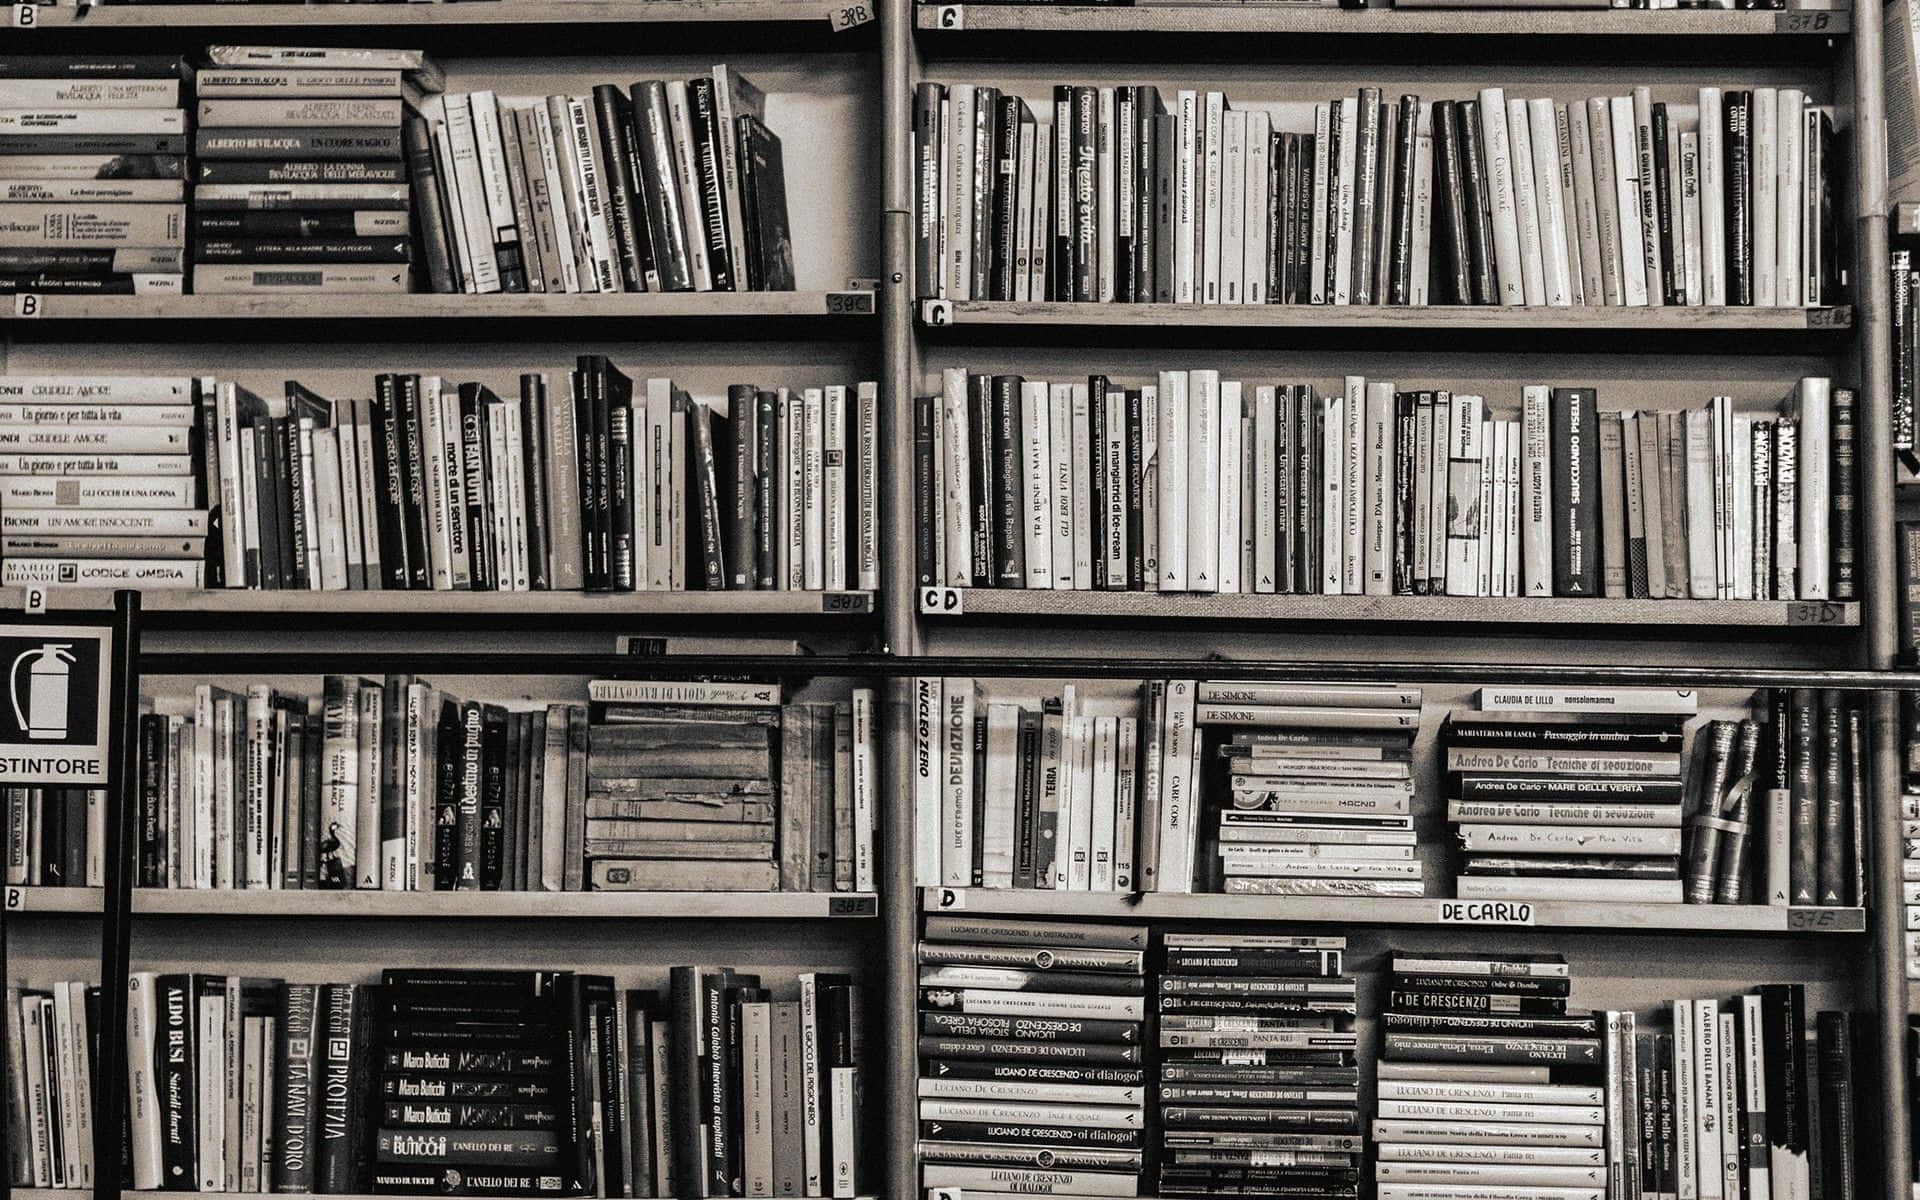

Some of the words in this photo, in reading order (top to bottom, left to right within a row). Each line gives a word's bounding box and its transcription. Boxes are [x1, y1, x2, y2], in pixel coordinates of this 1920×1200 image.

[20, 5, 33, 25] B
[840, 5, 867, 28] 38B
[1080, 94, 1091, 135] Costanzo
[1730, 106, 1738, 132] COVITO
[1738, 106, 1746, 137] CARMEN
[206, 139, 246, 148] ALBERTO
[247, 139, 300, 148] BEVILACQUA
[355, 139, 391, 147] MAGICO
[1558, 111, 1569, 158] COSTANTINI
[269, 170, 318, 180] BEVILACQUA
[324, 171, 348, 179] DELLE
[349, 171, 397, 179] MERAVIGLIE
[1562, 162, 1571, 188] Veleno
[1684, 152, 1696, 178] Carmen
[1302, 167, 1311, 208] CASANOVA
[1684, 178, 1696, 198] Covito
[1302, 211, 1309, 220] DI
[1301, 222, 1309, 248] AMORI
[23, 295, 36, 316] B
[1002, 382, 1011, 416] RAFFAELE
[22, 408, 33, 420] Un
[35, 411, 59, 424] giorno
[60, 411, 66, 420] e
[67, 411, 80, 425] per
[81, 408, 98, 420] tutta
[100, 408, 109, 420] la
[110, 408, 121, 420] vita
[1569, 394, 1581, 433] PISELLI
[1003, 418, 1012, 439] CROVI
[1111, 440, 1122, 449] le
[1779, 427, 1796, 483] DEVIAZIONE
[446, 442, 460, 476] morte
[1003, 448, 1014, 491] L'indagine
[1569, 435, 1581, 504] SBUCCIANDO
[449, 479, 462, 488] di
[1060, 462, 1069, 491] VINTI
[1111, 450, 1122, 502] mangiatrici
[451, 489, 461, 503] un
[1004, 493, 1014, 502] di
[1060, 494, 1069, 517] EROI
[1299, 500, 1309, 509] al
[1005, 503, 1014, 515] via
[1111, 504, 1122, 513] di
[4, 517, 40, 526] BIONDI
[48, 517, 61, 526] UN
[62, 517, 97, 526] AMORE
[99, 517, 152, 526] INNOCENTE
[451, 506, 465, 554] senatore
[1060, 520, 1069, 537] GLI
[1299, 510, 1309, 533] mare
[1005, 518, 1016, 549] Rapallo
[1111, 513, 1122, 560] ice-cream
[7, 573, 55, 581] BIONDI
[82, 569, 129, 578] CODICE
[136, 569, 183, 578] OMBRA
[30, 590, 42, 608] B
[926, 590, 940, 608] C
[945, 590, 958, 610] D
[1208, 692, 1221, 701] DE
[1222, 692, 1257, 701] SIMONE
[1494, 695, 1523, 705] CLAUDIA
[1525, 695, 1534, 705] DE
[1535, 695, 1554, 705] LILLO
[1564, 695, 1615, 705] nonsolomamma
[919, 680, 929, 737] NUCLEO
[1206, 711, 1219, 720] DE
[1220, 711, 1255, 720] SIMONE
[464, 710, 483, 748] pugno
[950, 695, 964, 786] DEVIAZIONE
[461, 749, 477, 760] in
[919, 739, 929, 778] ZERO
[1456, 754, 1493, 769] Andrea
[1496, 754, 1510, 769] De
[1512, 754, 1539, 769] Carlo
[1547, 758, 1588, 773] Tecniche
[1592, 759, 1602, 773] di
[1603, 760, 1653, 775] seduzione
[331, 755, 339, 777] TESTA
[458, 762, 478, 804] destino
[1045, 766, 1057, 798] TERRA
[1170, 776, 1180, 803] CARE
[462, 805, 477, 815] il
[1170, 804, 1180, 830] COSE
[1457, 803, 1495, 818] Andrea
[1498, 803, 1512, 818] De
[1513, 803, 1540, 818] Carlo
[1548, 806, 1590, 820] Tecniche
[1593, 807, 1603, 821] di
[1604, 808, 1656, 823] seduzione
[8, 890, 20, 907] B
[939, 890, 955, 907] D
[1442, 901, 1464, 922] DE
[1467, 902, 1530, 922] CARLO
[168, 988, 184, 1026] ALDO
[1405, 993, 1419, 1009] DE
[1423, 993, 1487, 1009] CRESCENZO
[935, 1015, 965, 1026] GRECA
[950, 1026, 976, 1035] DELLA
[967, 1017, 1010, 1028] FILOSOFIA
[1016, 1020, 1064, 1031] CRESCENZO
[1067, 1020, 1082, 1031] DE
[1702, 1005, 1713, 1045] L'ALBERO
[982, 1027, 1009, 1036] STORIA
[1015, 1029, 1056, 1039] LUCIANO
[168, 1030, 184, 1063] BUSI
[805, 1030, 815, 1061] GIOCO
[403, 1051, 424, 1069] Marco
[425, 1051, 450, 1069] Buticchi
[806, 1061, 816, 1076] DEL
[1702, 1047, 1713, 1072] DELLE
[995, 1067, 1027, 1077] LUCIANO
[1029, 1068, 1037, 1077] DE
[1038, 1069, 1080, 1080] CRESCENZO
[1085, 1071, 1094, 1081] oi
[1097, 1070, 1140, 1085] dialogoi
[168, 1071, 182, 1106] Suicidi
[398, 1080, 419, 1096] Marco
[420, 1080, 445, 1096] Buticchi
[1702, 1073, 1713, 1109] BANANE
[806, 1077, 817, 1126] PRIGIONIERO
[404, 1105, 424, 1123] Marco
[425, 1105, 451, 1123] Buticchi
[988, 1127, 1019, 1138] LUCIANO
[1021, 1128, 1030, 1138] DE
[1031, 1128, 1073, 1141] CRESCENZO
[1078, 1131, 1088, 1141] oi
[1089, 1129, 1133, 1144] dialogoi
[393, 1142, 446, 1156] BUTICCHI
[503, 1144, 513, 1152] RE
